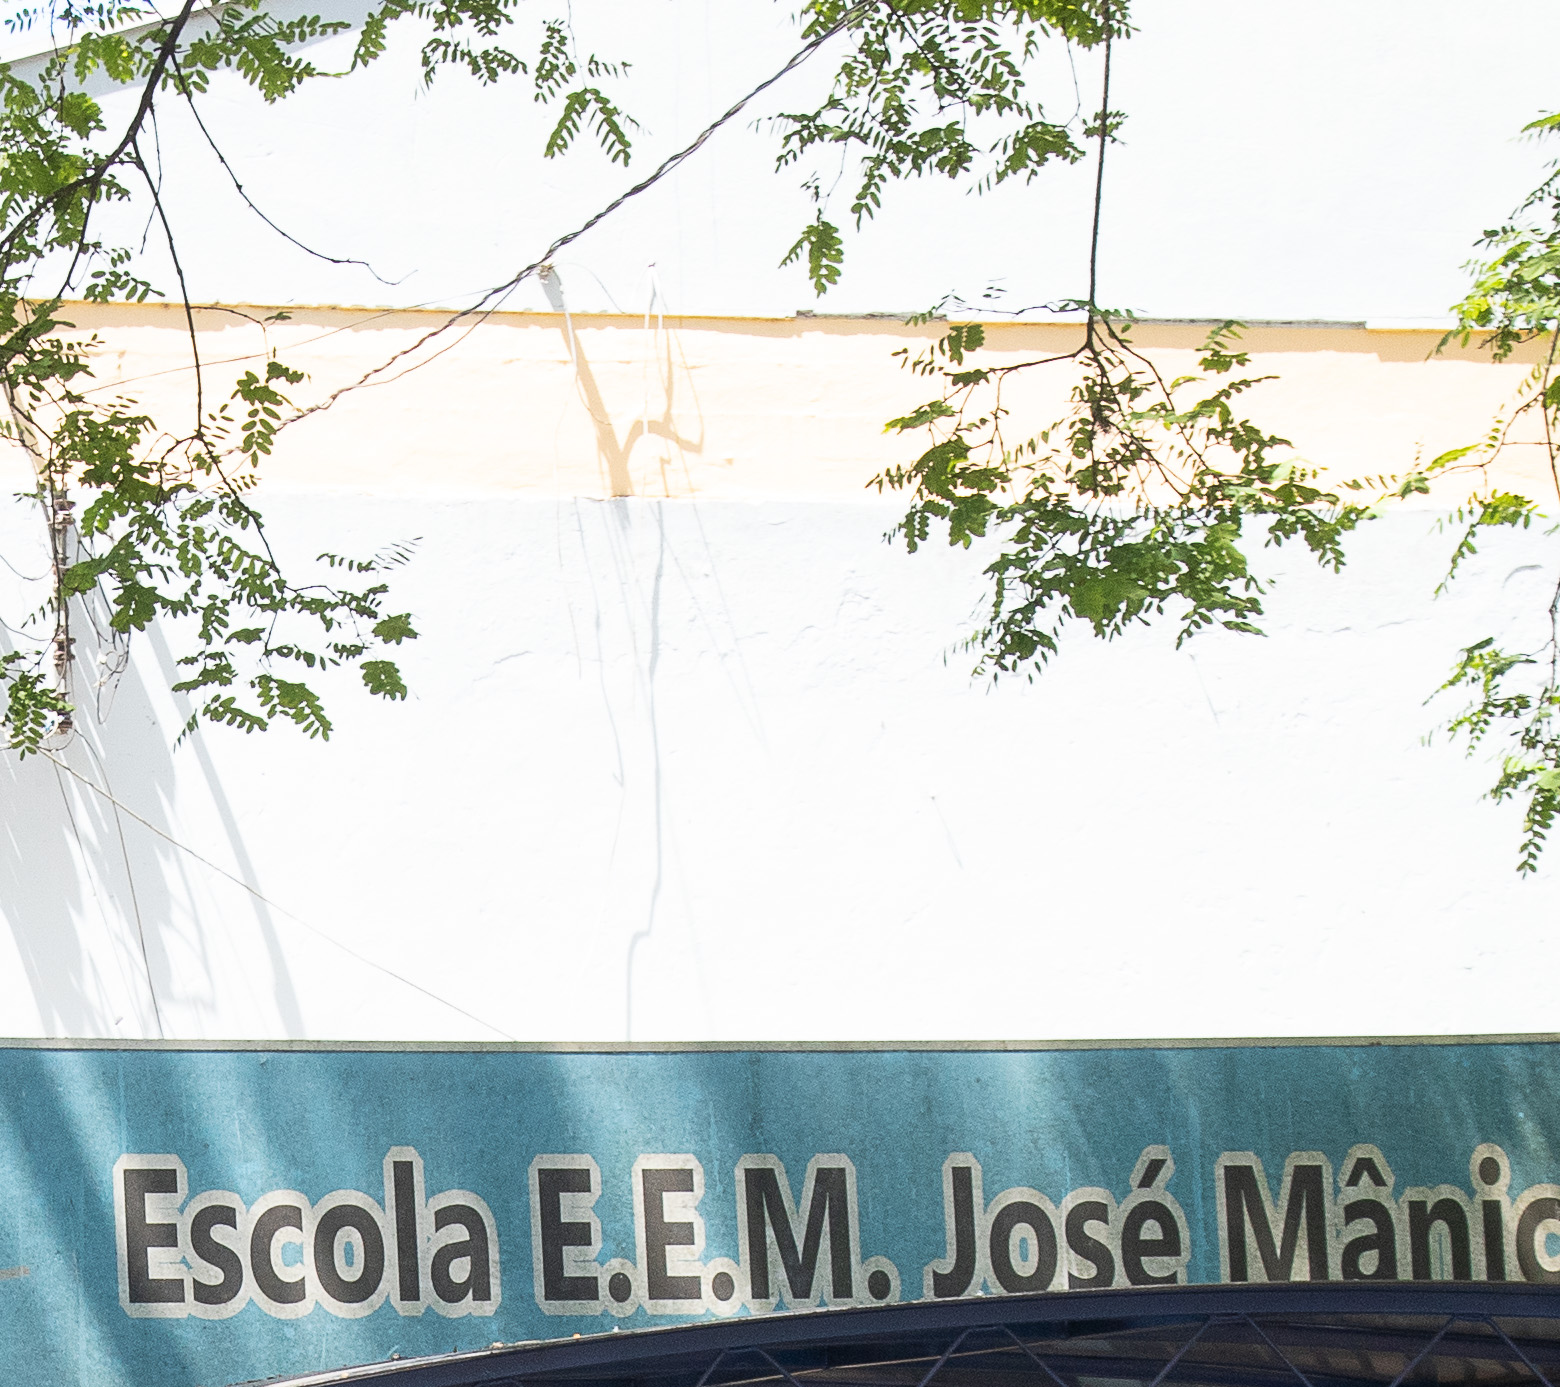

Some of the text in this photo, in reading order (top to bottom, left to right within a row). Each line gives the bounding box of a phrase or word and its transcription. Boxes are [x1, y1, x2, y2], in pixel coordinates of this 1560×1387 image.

[120, 1158, 493, 1306] Escola
[535, 1165, 893, 1304] E.E.M.
[931, 1157, 1183, 1296] José
